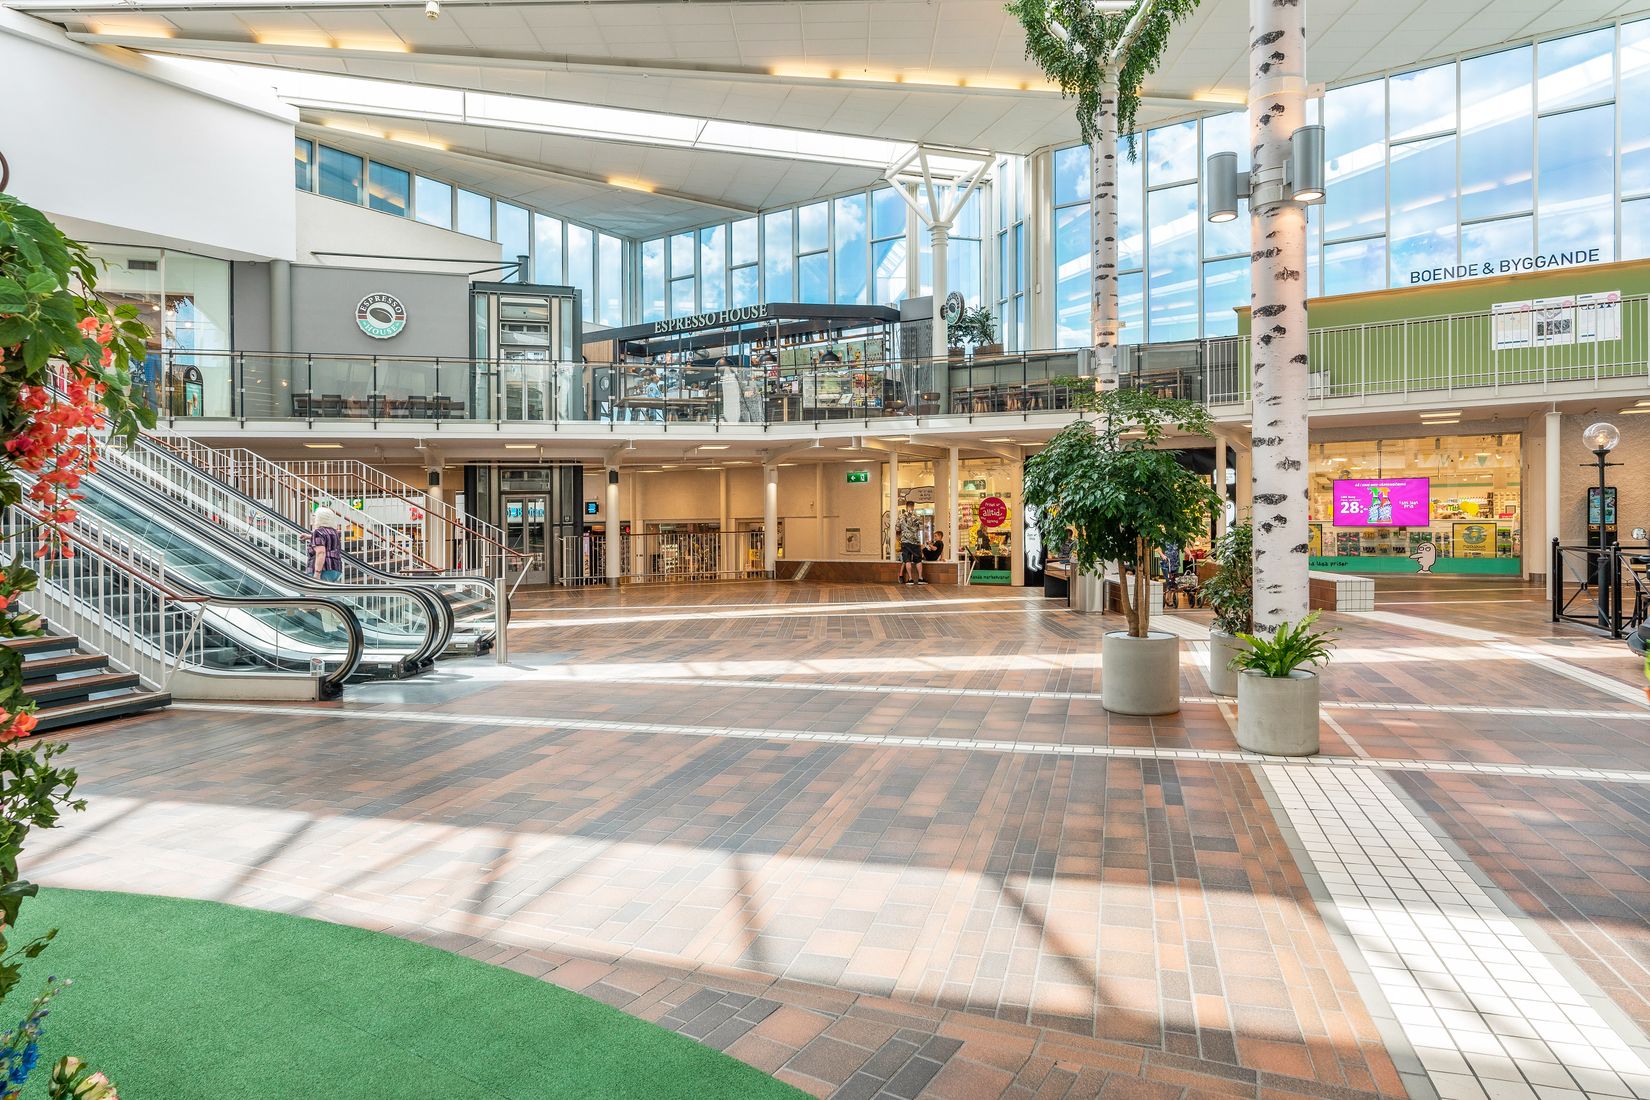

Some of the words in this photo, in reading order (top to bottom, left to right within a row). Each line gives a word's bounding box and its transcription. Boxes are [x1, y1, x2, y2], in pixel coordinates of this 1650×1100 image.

[1410, 264, 1478, 284] BOENDE
[1482, 262, 1494, 275] &
[1500, 248, 1600, 273] BYGGANDE
[360, 295, 402, 313] ESPRESSO
[365, 325, 398, 336] HOUSE
[654, 311, 716, 334] ESPRESSO
[719, 304, 768, 324] HOUSE
